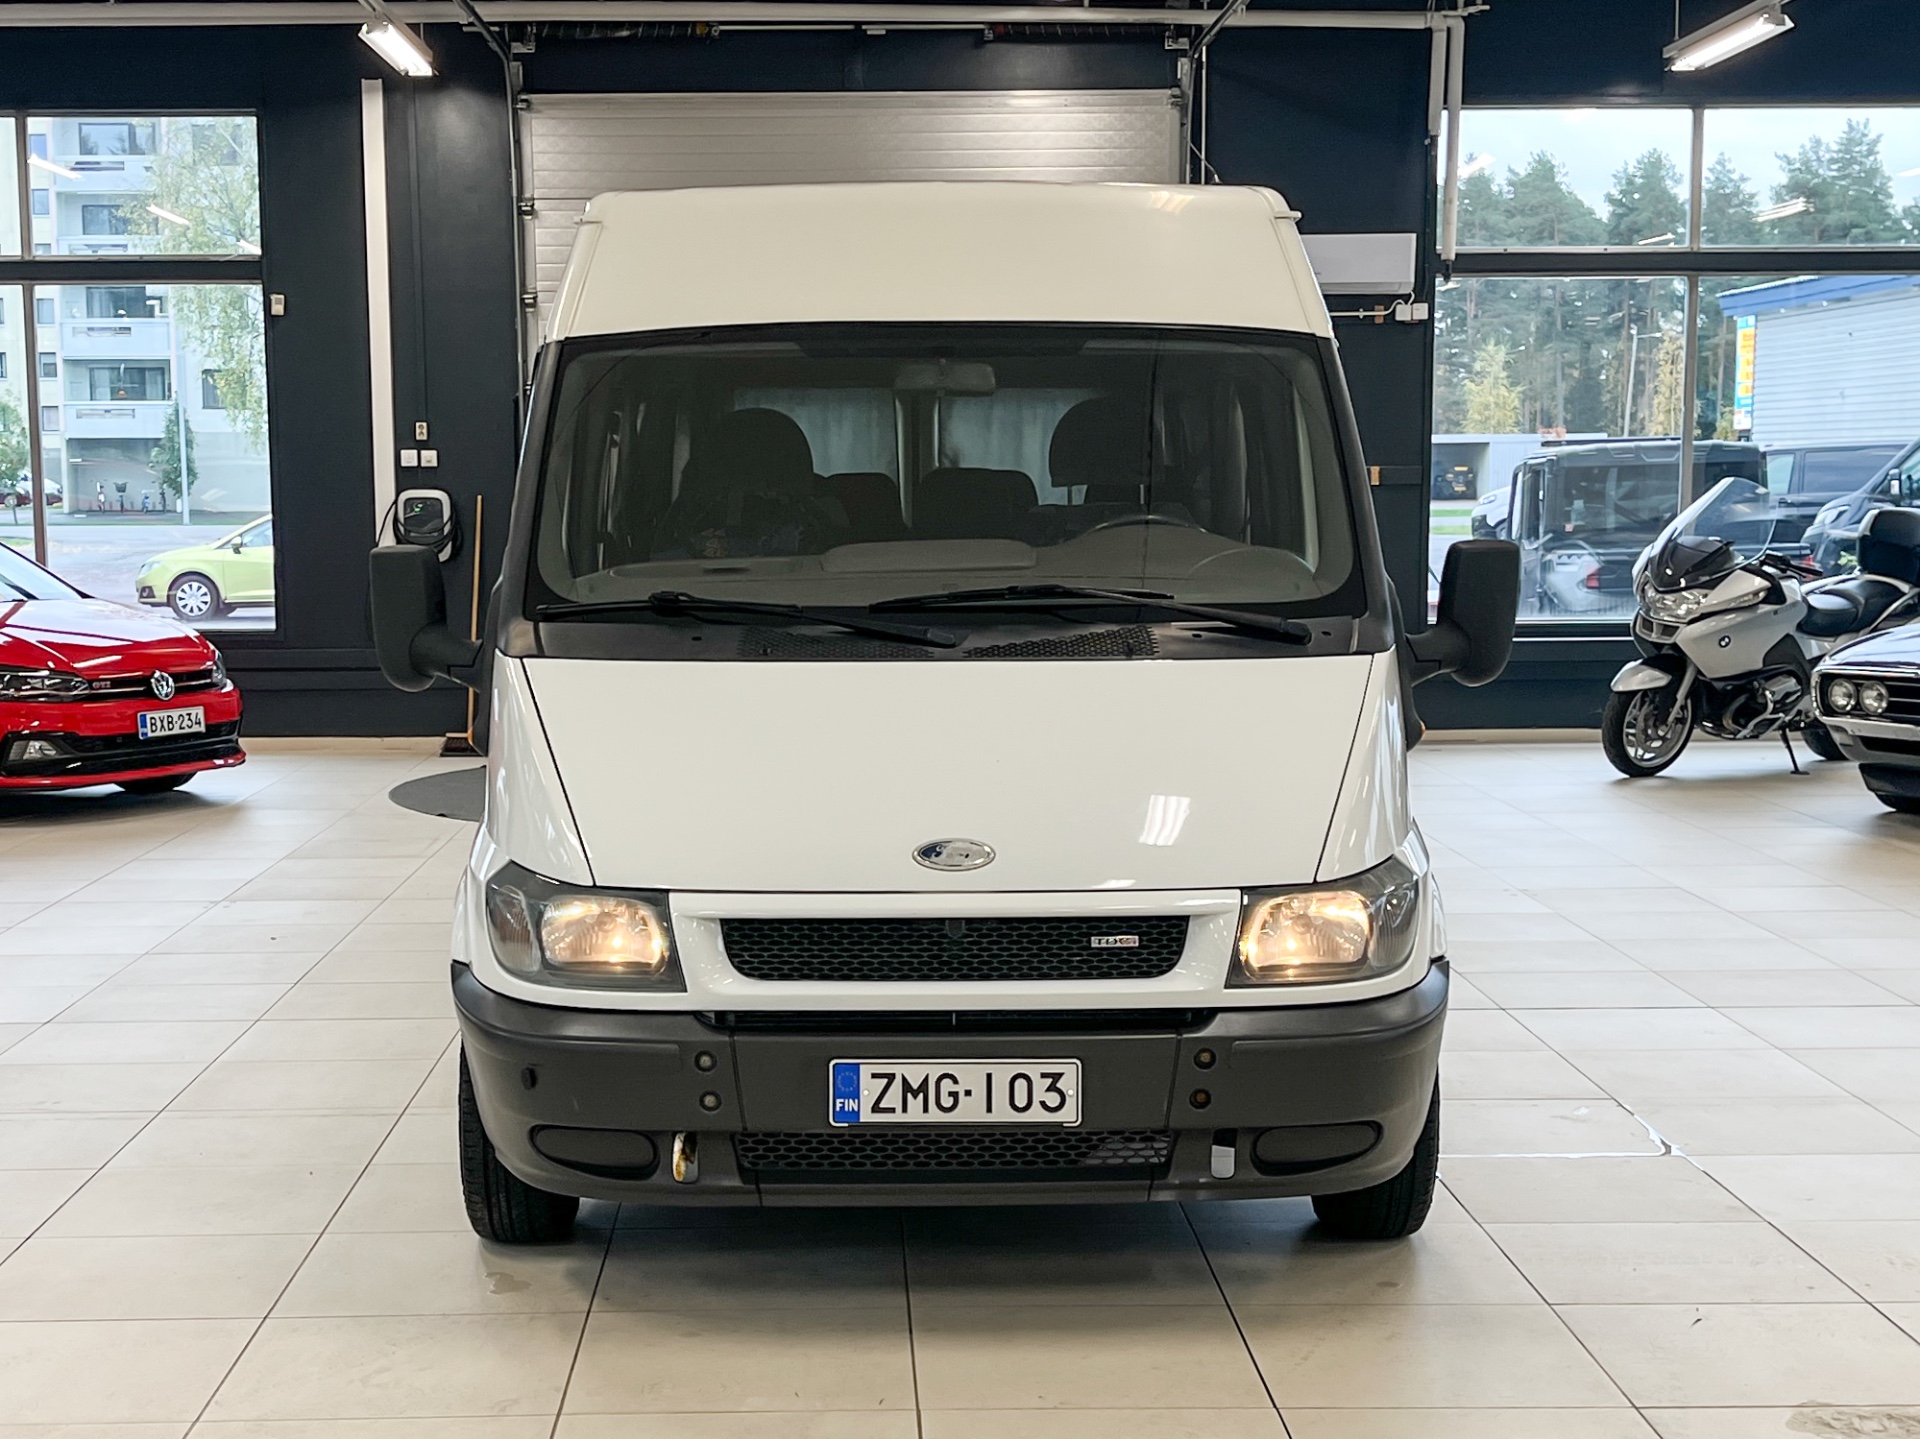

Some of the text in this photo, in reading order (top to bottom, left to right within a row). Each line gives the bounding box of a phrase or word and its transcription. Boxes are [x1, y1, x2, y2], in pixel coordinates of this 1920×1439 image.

[149, 711, 202, 734] BXB-234
[835, 1097, 859, 1113] FIN
[870, 1072, 1067, 1115] ZMG-103
